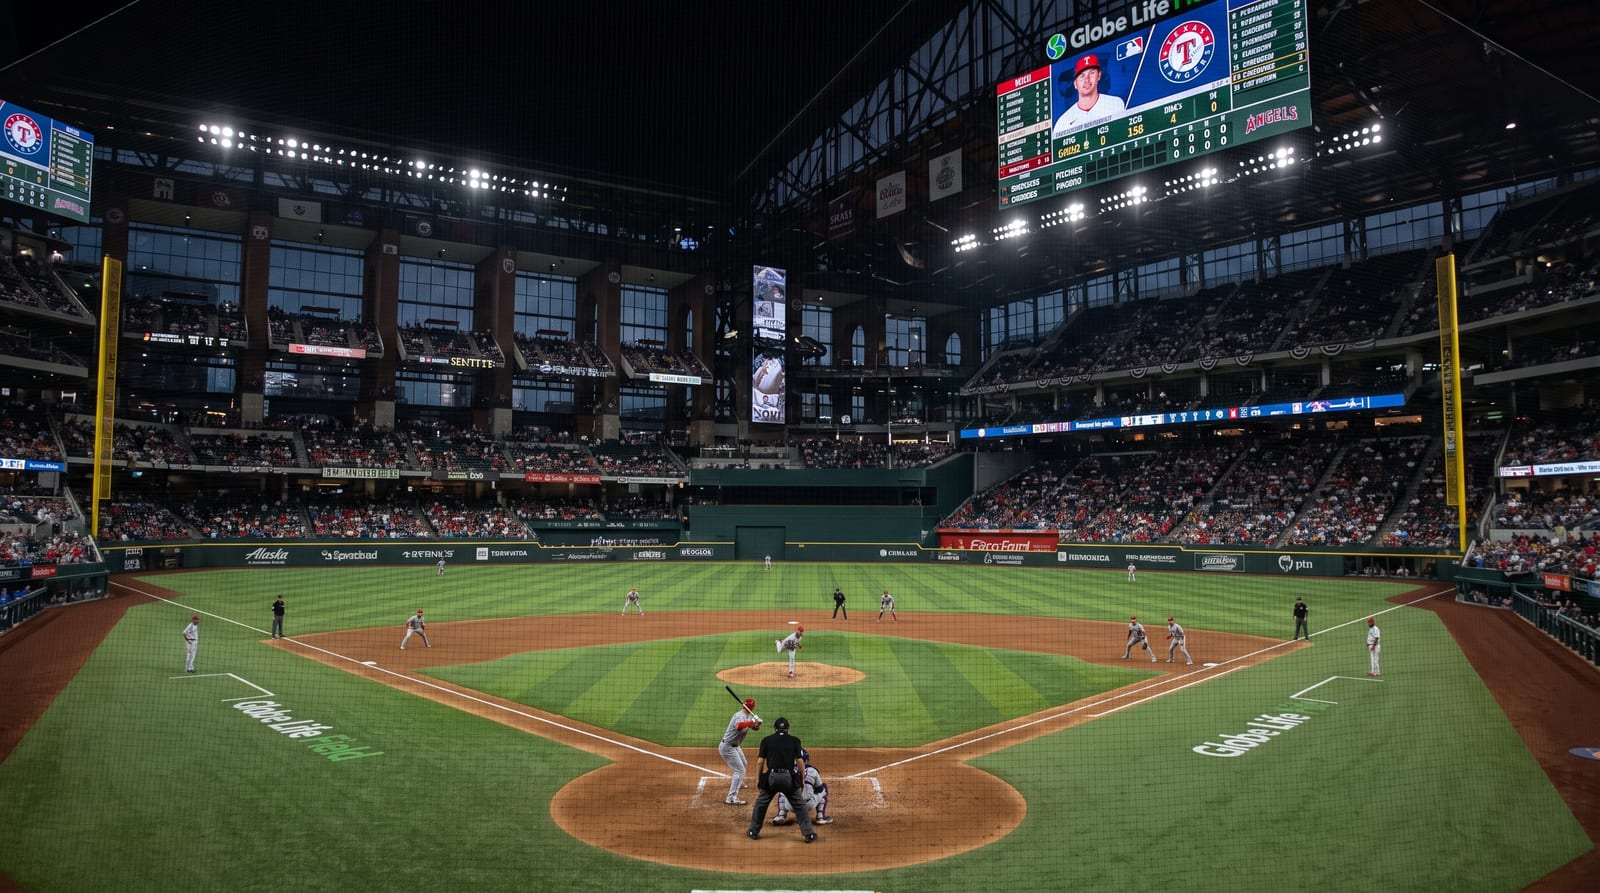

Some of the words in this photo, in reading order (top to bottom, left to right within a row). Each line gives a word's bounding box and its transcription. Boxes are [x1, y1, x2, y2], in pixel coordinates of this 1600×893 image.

[1070, 17, 1127, 49] Globe
[1131, 0, 1169, 27] Life
[1166, 24, 1206, 45] TEXAS
[1176, 38, 1197, 66] T
[1163, 50, 1211, 79] RANGERS
[1211, 101, 1217, 112] 0
[1170, 113, 1177, 124] 4
[1245, 105, 1299, 135] ANGELS
[1100, 135, 1106, 146] 0
[1173, 137, 1180, 147] 0
[1188, 134, 1195, 144] 0
[1204, 129, 1210, 139] 0
[1220, 124, 1227, 134] 0
[1173, 149, 1180, 159] 0
[1188, 145, 1195, 154] 0
[1204, 140, 1210, 150] 0
[1220, 136, 1227, 145] 0
[245, 547, 289, 560] Alaska
[1192, 727, 1280, 757] Globe
